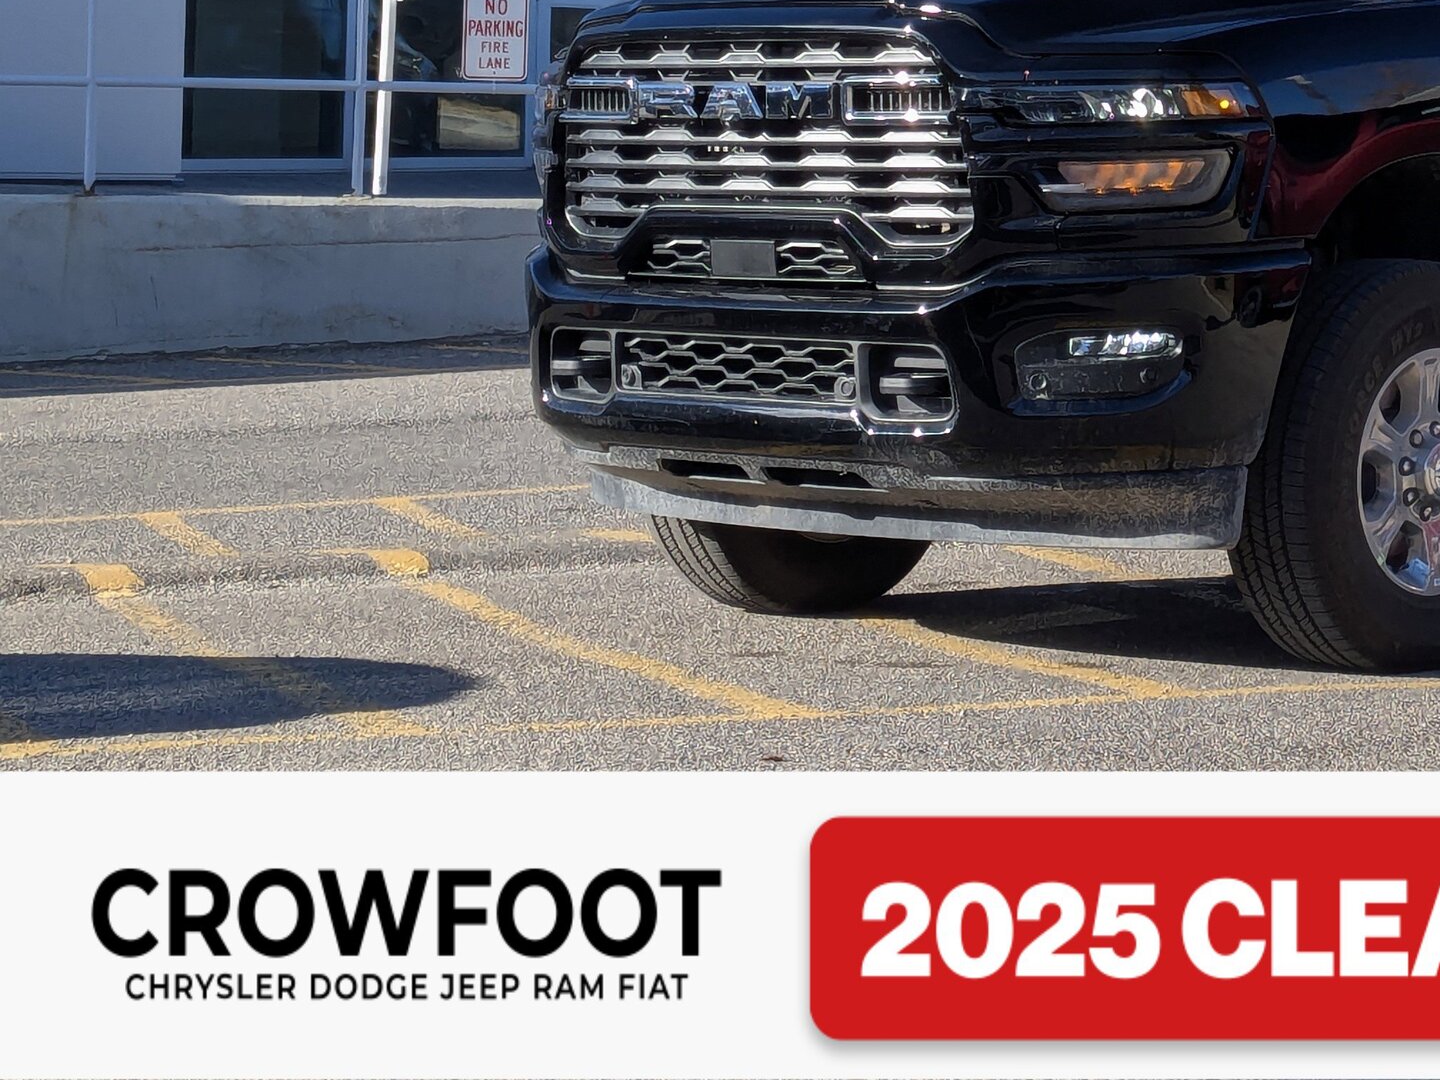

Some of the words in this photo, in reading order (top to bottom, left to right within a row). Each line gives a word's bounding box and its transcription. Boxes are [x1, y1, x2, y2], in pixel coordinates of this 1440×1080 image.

[468, 19, 524, 38] PARKING
[481, 41, 509, 54] FIRE
[478, 56, 511, 70] LANE
[638, 80, 834, 120] RAM
